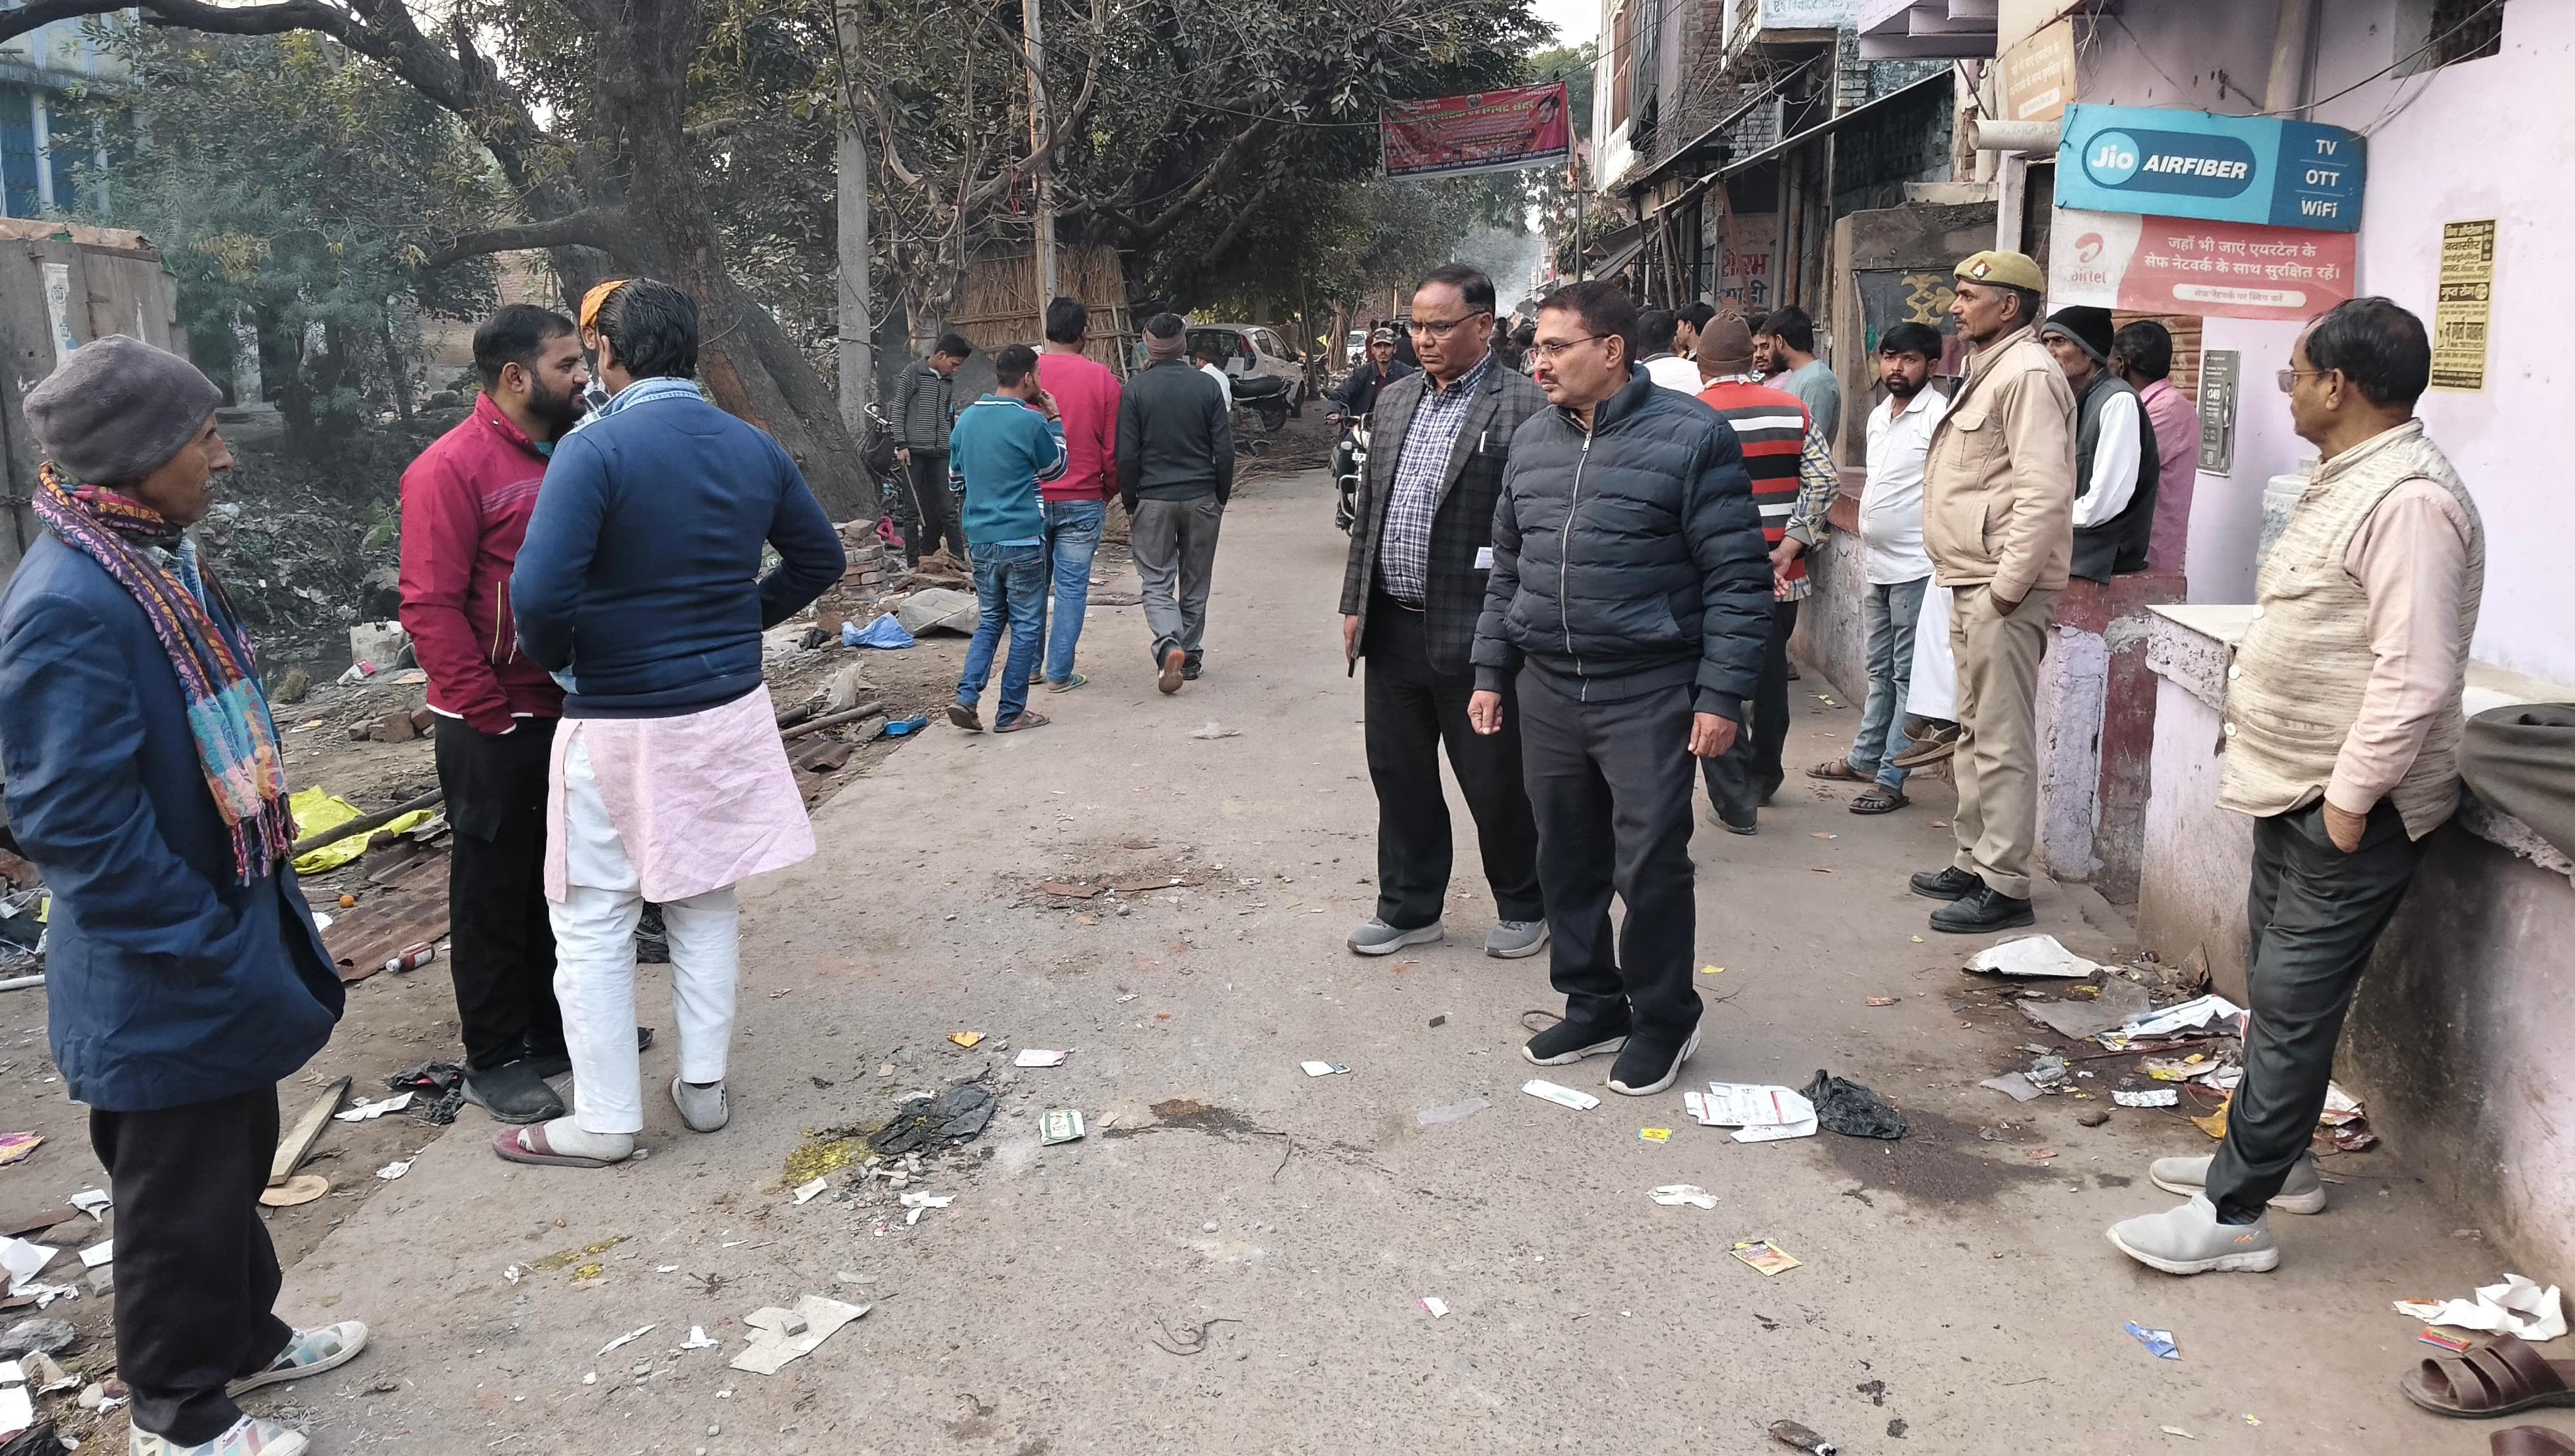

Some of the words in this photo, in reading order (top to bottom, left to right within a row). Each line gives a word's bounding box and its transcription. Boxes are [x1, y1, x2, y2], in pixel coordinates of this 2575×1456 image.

[2315, 139, 2338, 155] TV
[2091, 145, 2134, 170] Jio
[2142, 155, 2247, 179] AIRFIBER
[2306, 169, 2340, 187] OTT
[2301, 199, 2338, 218] WiFi
[2168, 235, 2195, 251] जहाँ
[2198, 236, 2215, 251] भी
[2218, 240, 2246, 256] जाएं
[2249, 241, 2299, 257] एयरटेल
[2301, 242, 2317, 257] के
[2144, 251, 2169, 268] सेफ
[2172, 254, 2213, 272] नेटवर्क
[2215, 257, 2230, 273] के
[2233, 263, 2262, 275] साथ
[2264, 262, 2313, 280] सुरक्षित
[2072, 269, 2107, 284] airtel
